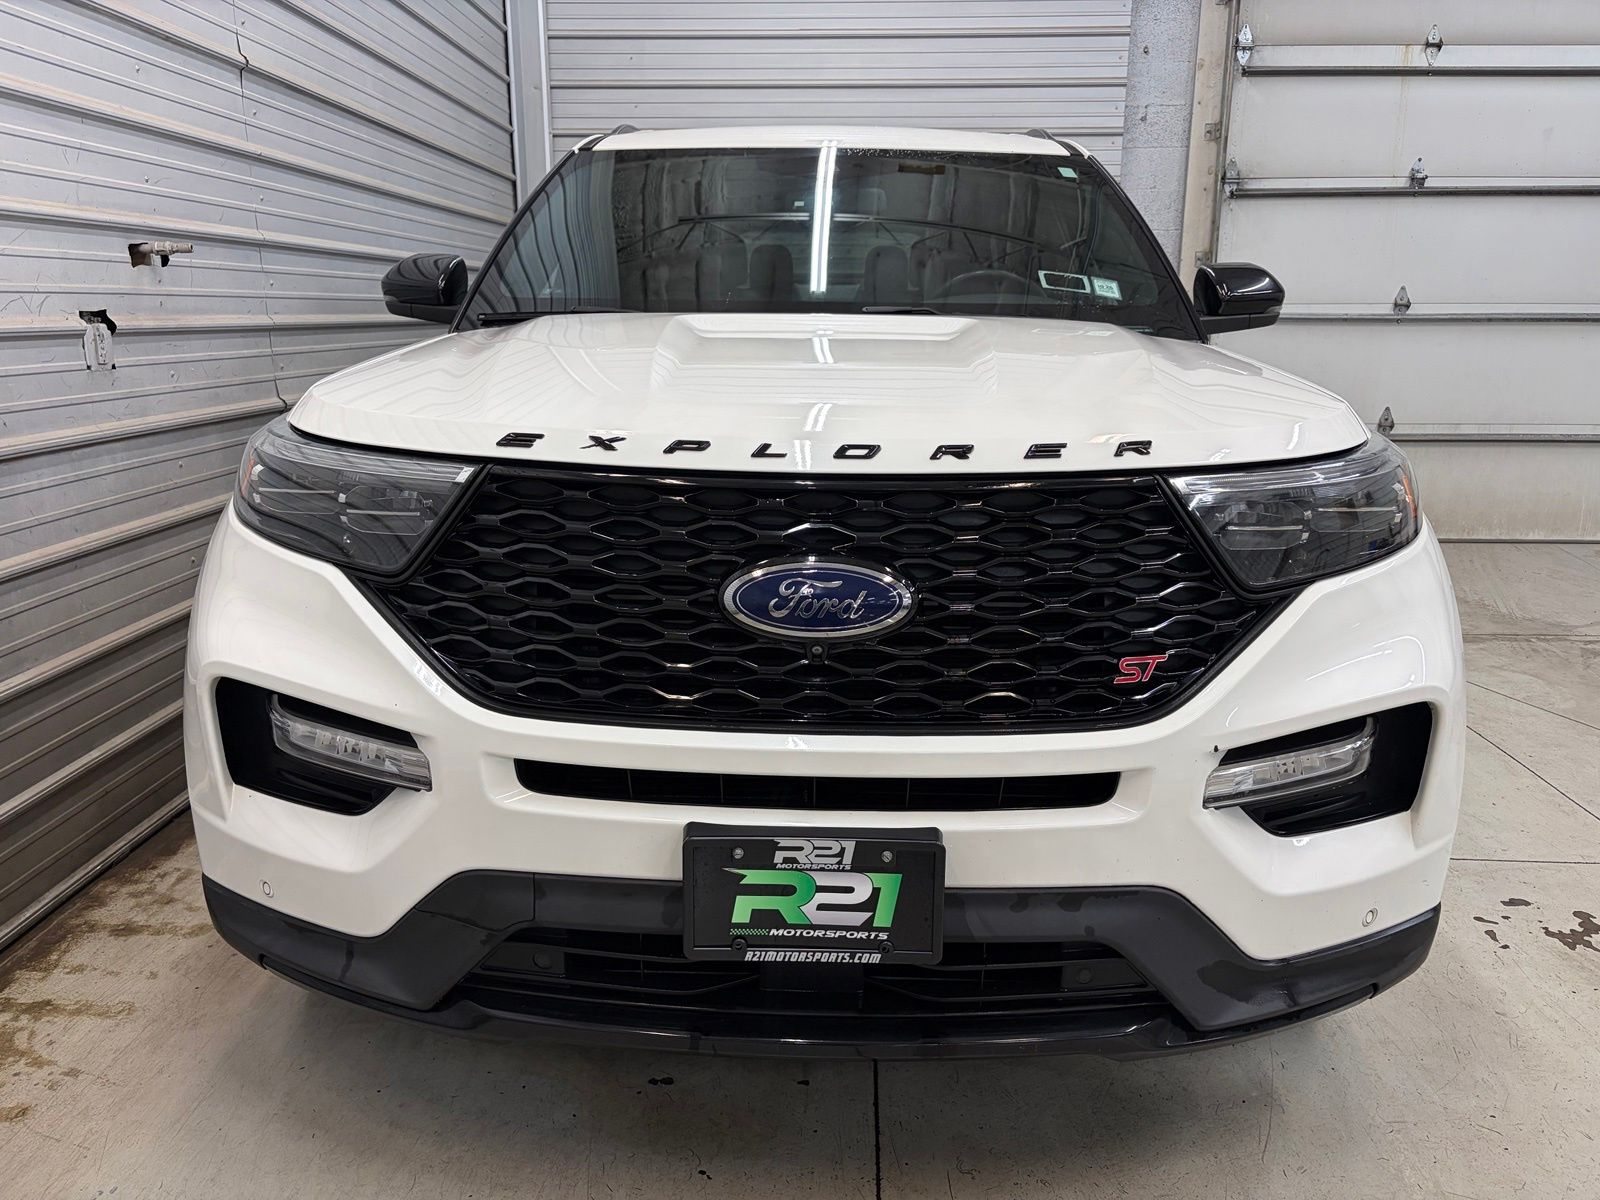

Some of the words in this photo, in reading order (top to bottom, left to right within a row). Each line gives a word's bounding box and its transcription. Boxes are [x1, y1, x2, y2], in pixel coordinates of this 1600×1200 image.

[496, 432, 1153, 460] EXPLORER
[768, 577, 868, 619] Ford
[1113, 654, 1168, 684] ST
[773, 839, 857, 865] R21
[721, 867, 903, 928] R21
[769, 928, 890, 940] MOTORSPORTS
[744, 951, 882, 964] R21MOTORSPORTS.COM
